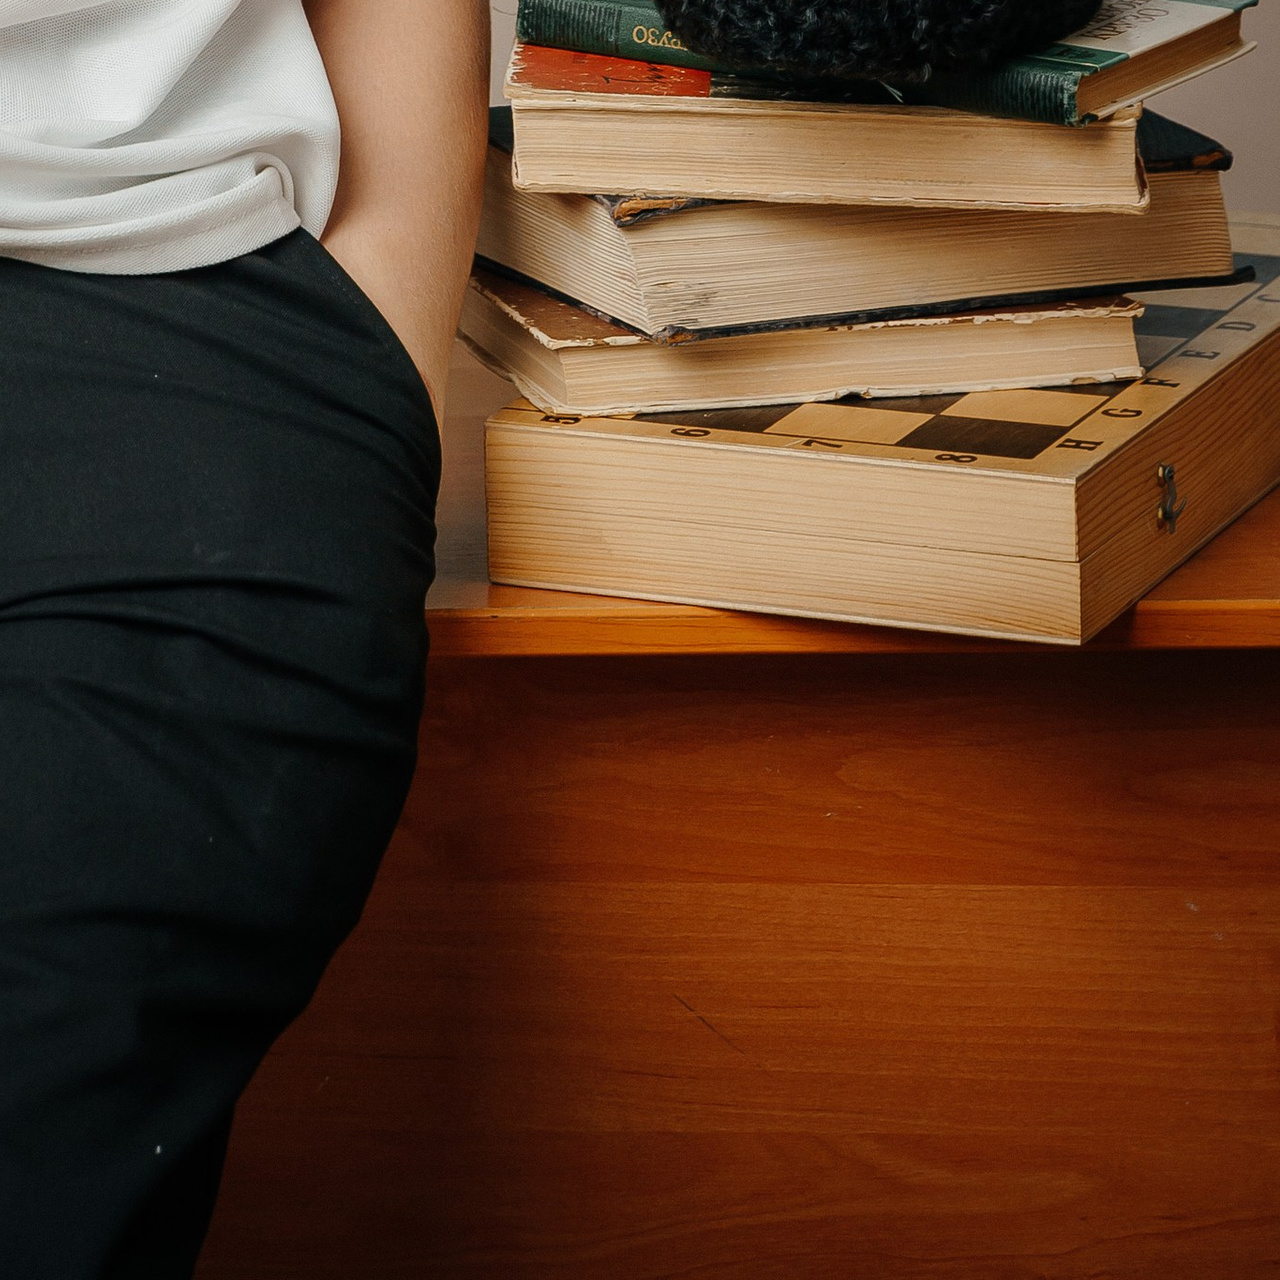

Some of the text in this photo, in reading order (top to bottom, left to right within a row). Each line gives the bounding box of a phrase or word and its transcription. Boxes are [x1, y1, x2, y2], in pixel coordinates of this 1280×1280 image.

[1056, 437, 1105, 452] H
[1100, 407, 1144, 419] G
[1139, 377, 1182, 389] F
[1176, 348, 1221, 361] E
[1216, 321, 1257, 332] D
[670, 426, 712, 438] 6
[800, 437, 844, 449] 7
[934, 452, 979, 464] 8
